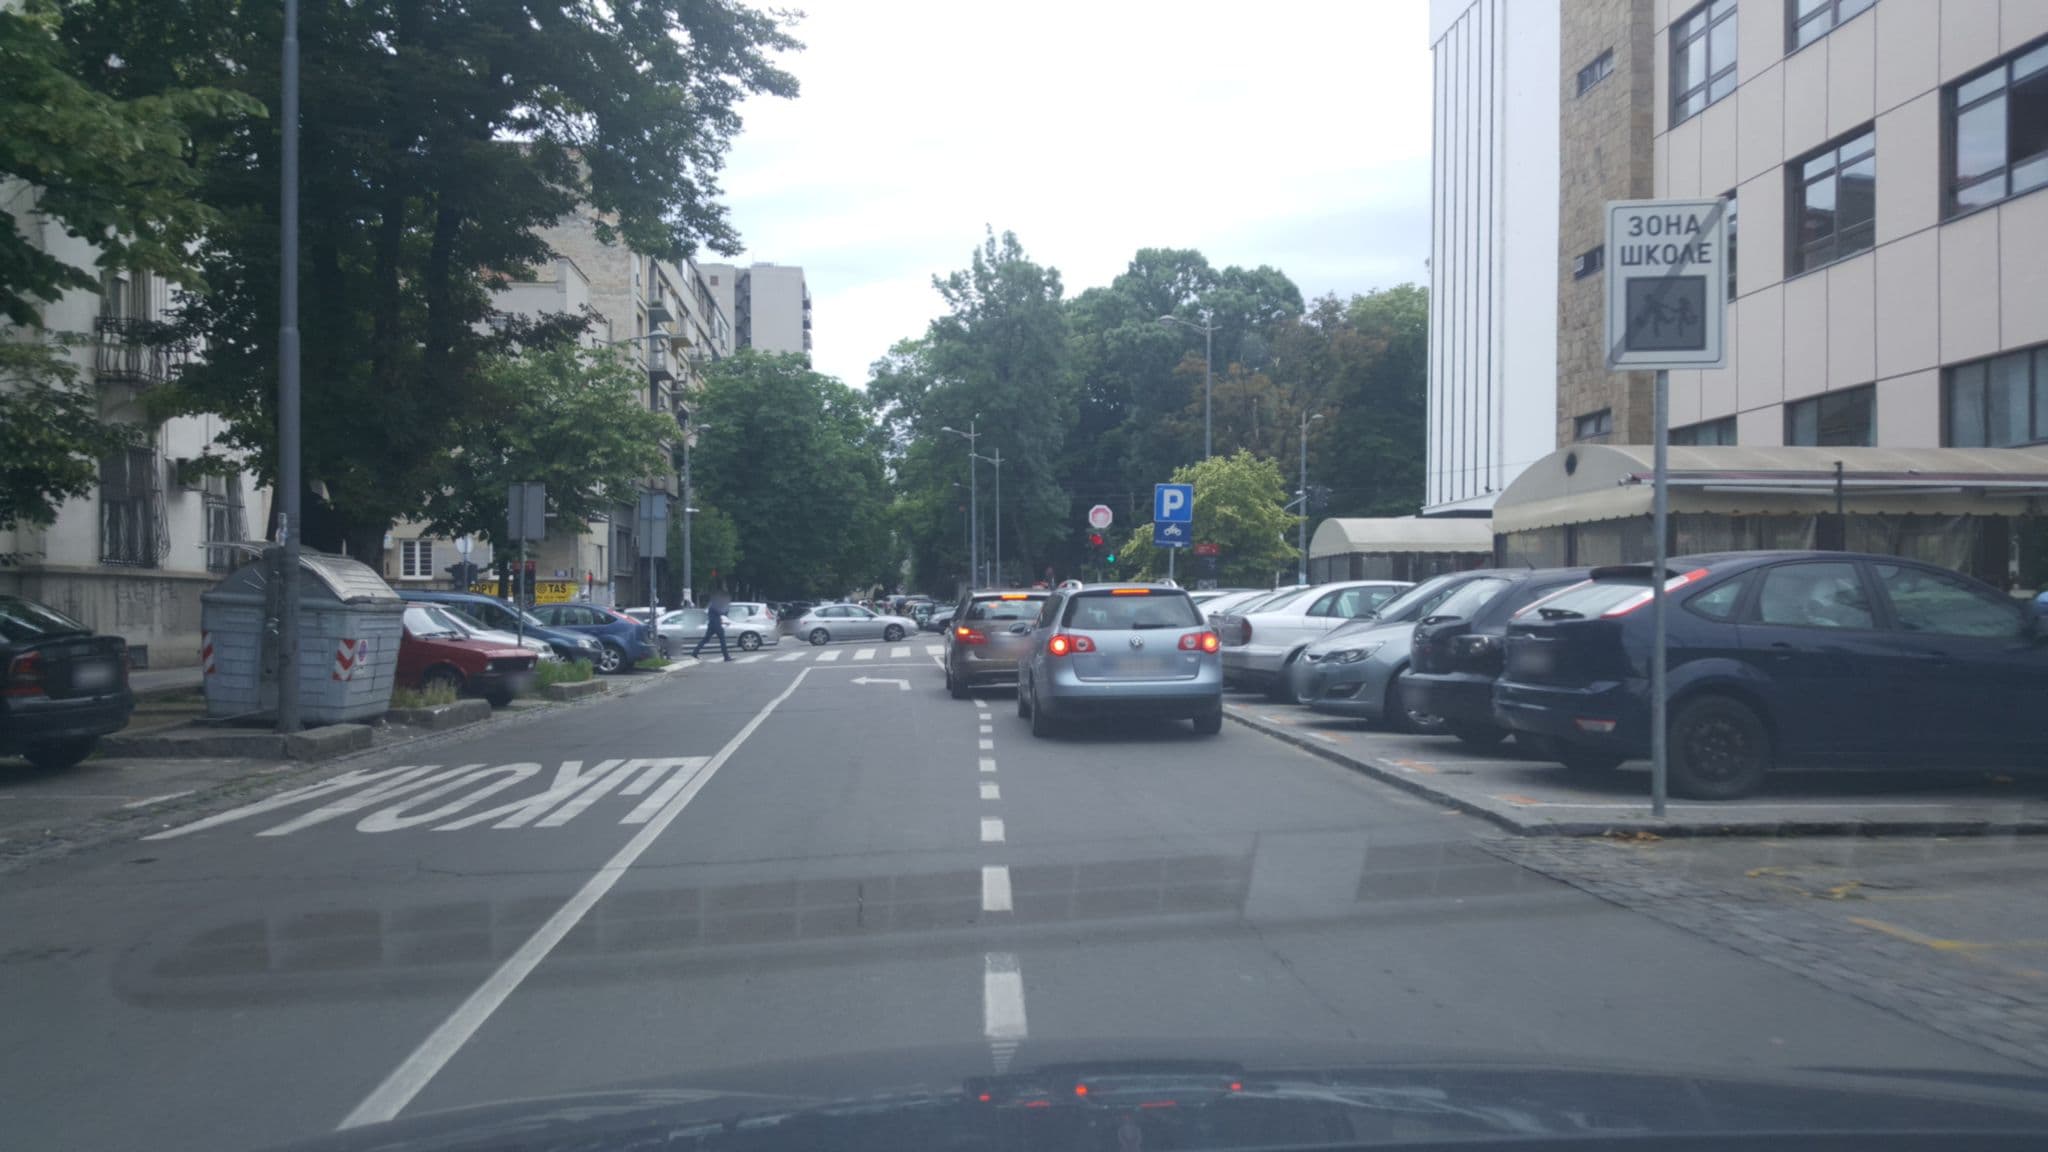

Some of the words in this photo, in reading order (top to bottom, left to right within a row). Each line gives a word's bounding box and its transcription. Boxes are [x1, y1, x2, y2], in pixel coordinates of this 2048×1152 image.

[1628, 213, 1702, 237] ЗОНА
[1620, 242, 1713, 267] ШКОЛЕ
[1162, 488, 1185, 518] P
[548, 583, 567, 593] TAS
